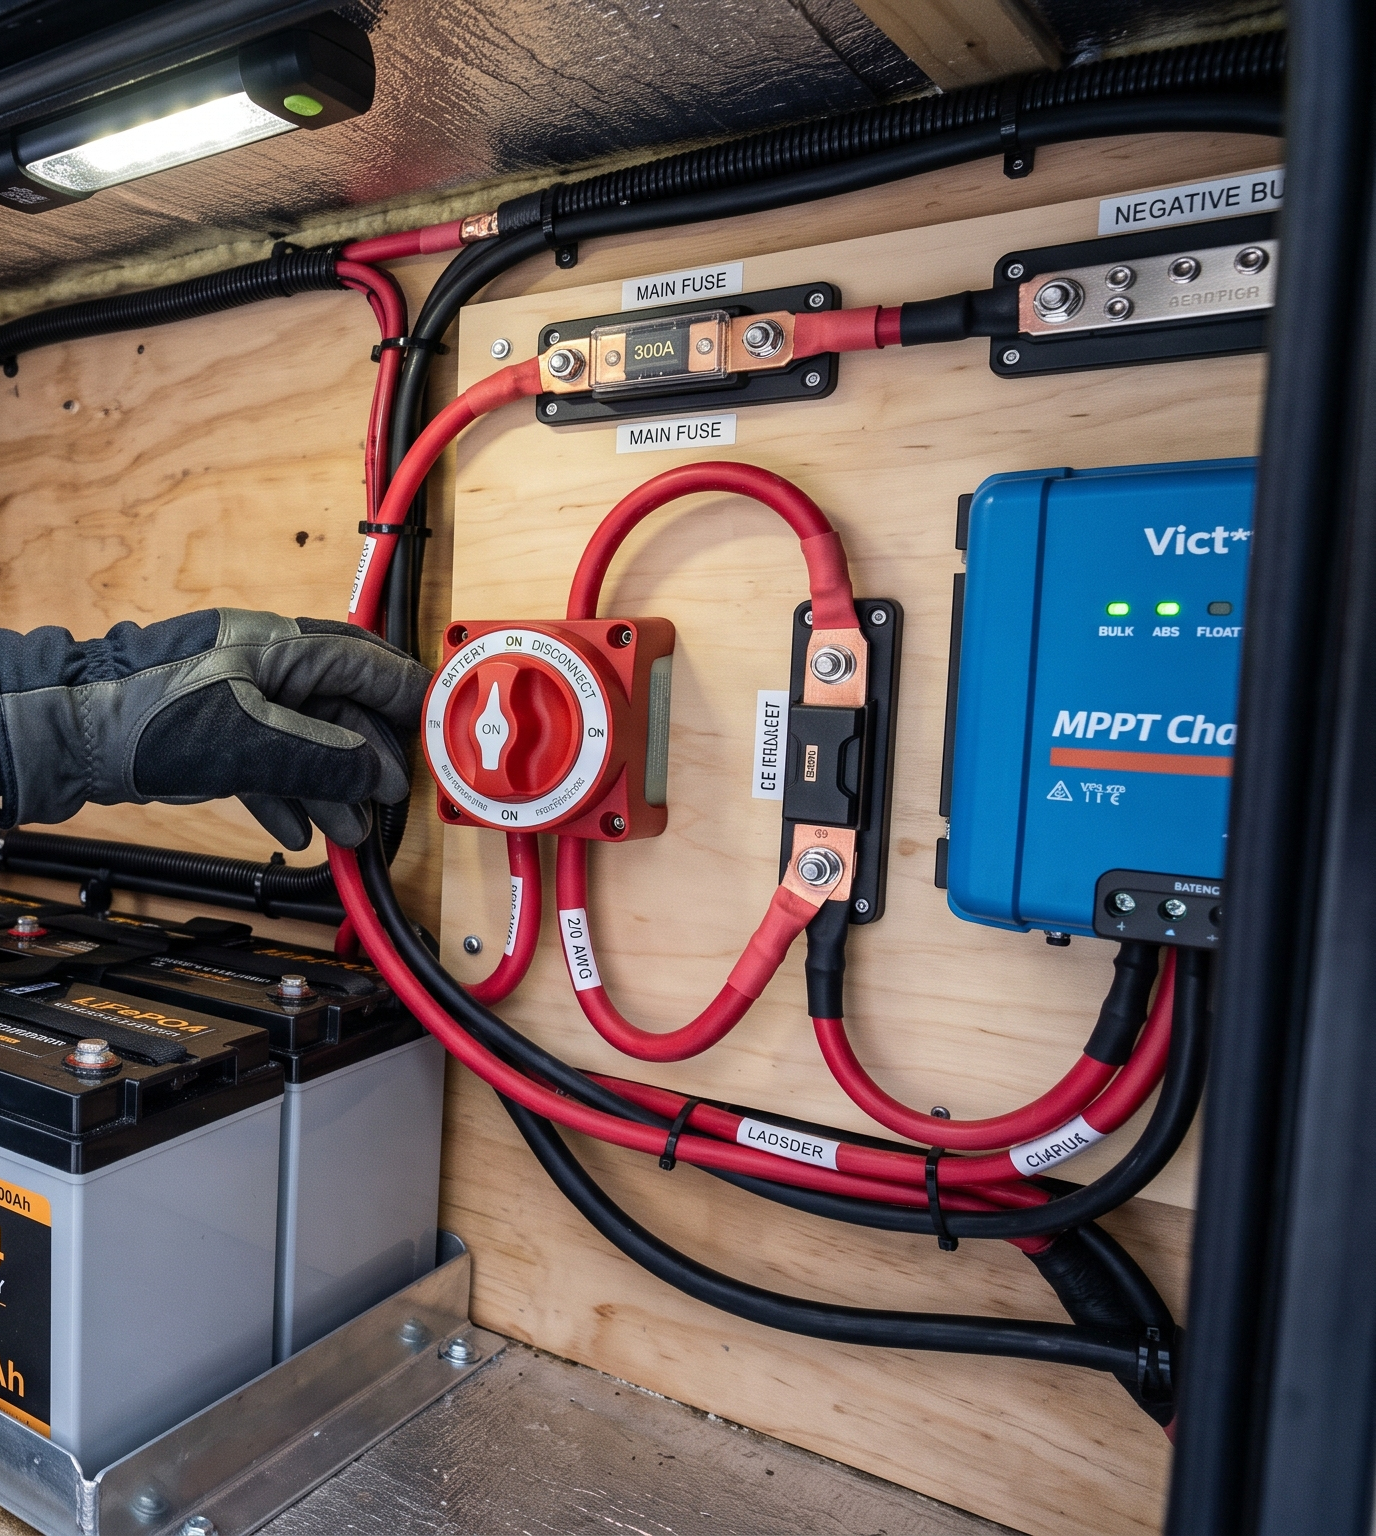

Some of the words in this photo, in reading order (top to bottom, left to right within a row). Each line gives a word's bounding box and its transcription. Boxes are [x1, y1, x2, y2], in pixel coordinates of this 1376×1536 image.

[1115, 185, 1241, 226] NEGATIVE
[636, 280, 676, 301] MAIN
[682, 271, 727, 295] FUSE
[634, 340, 674, 360] 300A
[629, 426, 671, 445] MAIN
[676, 421, 722, 441] FUSE
[1098, 625, 1135, 637] BULK
[1152, 625, 1180, 637] ABS
[1196, 626, 1241, 638] FLOAT
[441, 642, 487, 689] BATTERY
[505, 635, 523, 647] ON
[531, 639, 597, 700] DISCONNECT
[481, 723, 501, 735] ON
[587, 727, 604, 738] ON
[1051, 710, 1162, 742] MPPT
[501, 809, 518, 821] ON
[567, 917, 583, 939] 2/0
[572, 945, 593, 980] AWG
